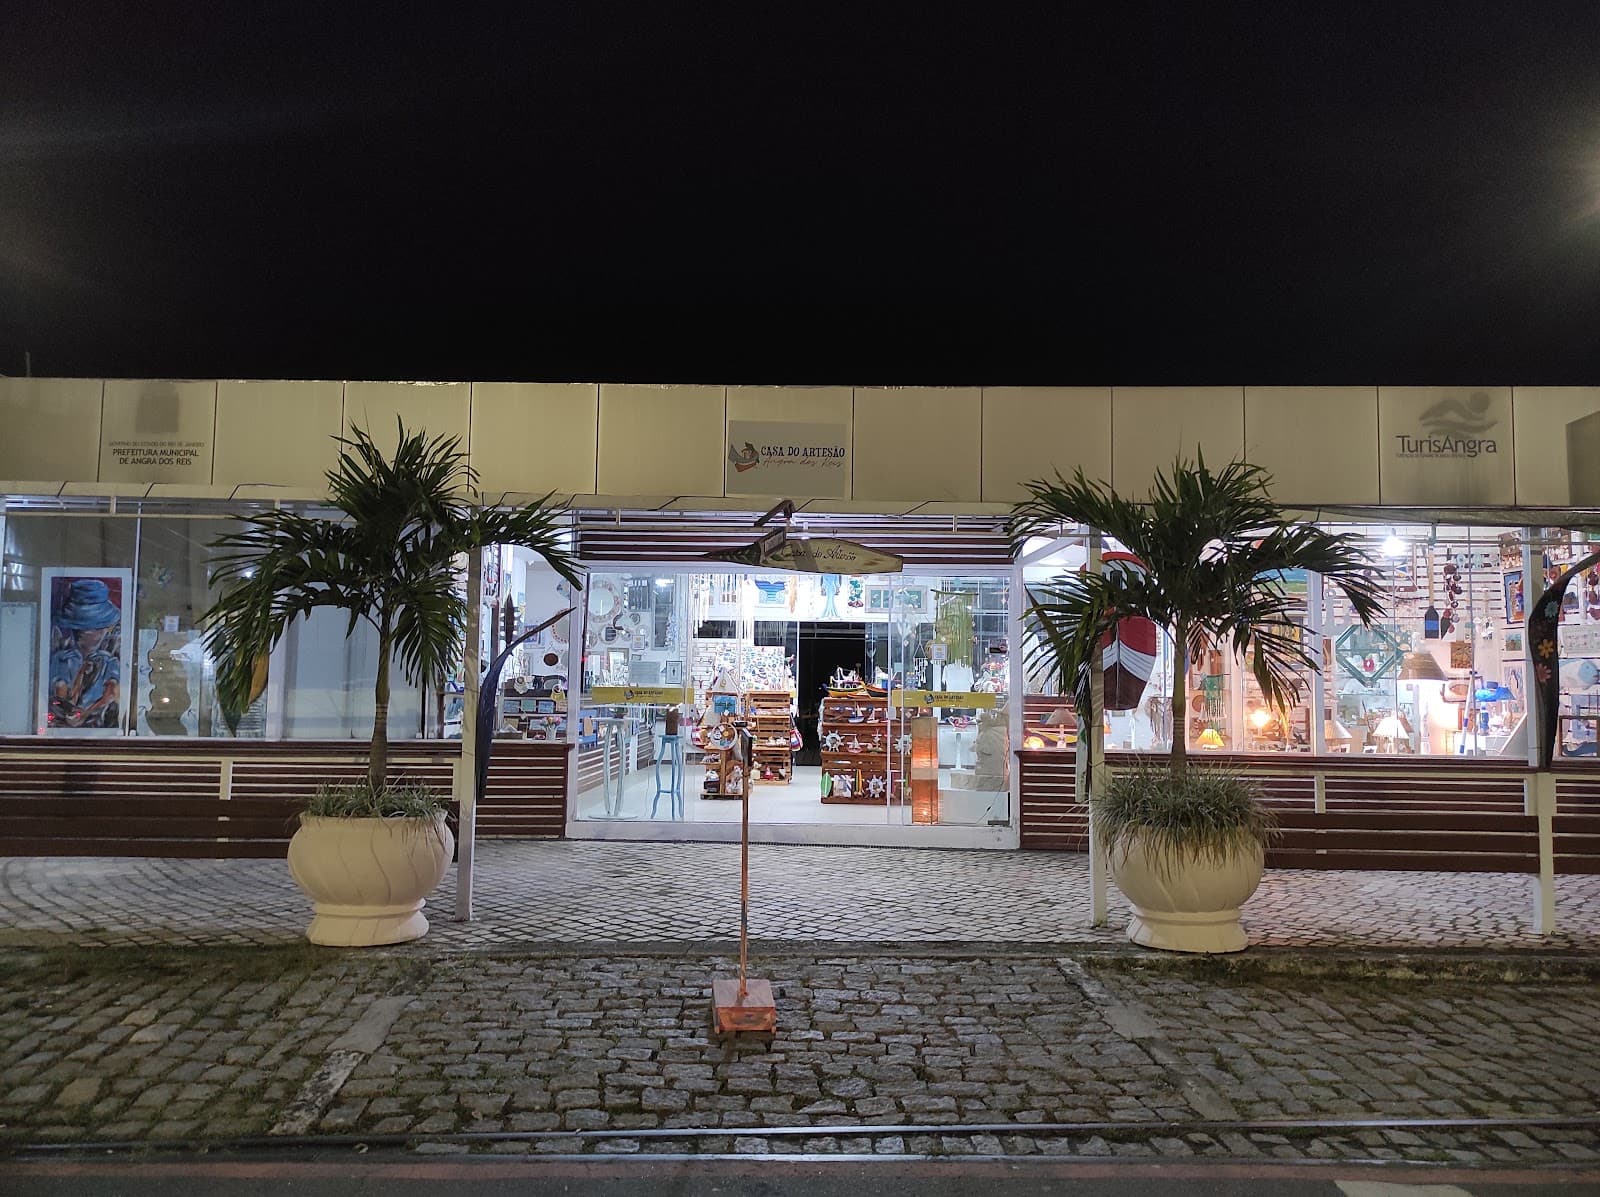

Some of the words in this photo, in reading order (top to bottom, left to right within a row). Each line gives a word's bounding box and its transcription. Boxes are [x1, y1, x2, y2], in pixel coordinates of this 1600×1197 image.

[1395, 435, 1497, 457] TurisAngra
[112, 448, 158, 456] PREFEITURA
[159, 449, 199, 457] MUNICIPAL
[761, 446, 784, 456] CASA
[787, 447, 799, 456] DO
[802, 446, 845, 457] ARTESÃO
[176, 458, 192, 466] REIS
